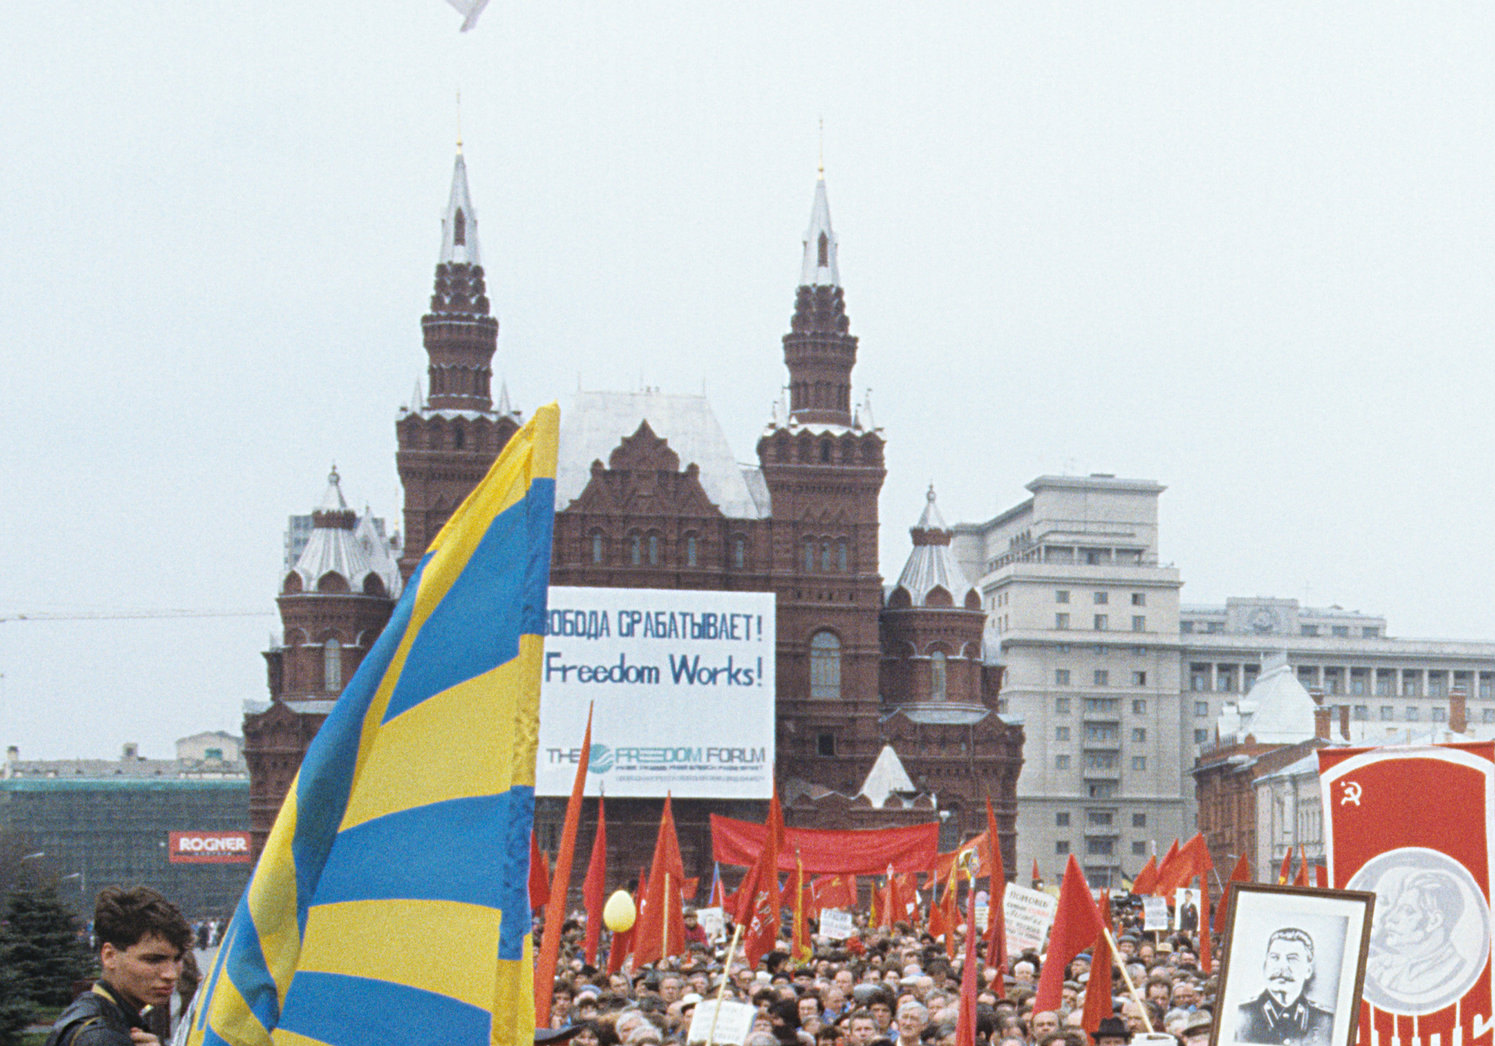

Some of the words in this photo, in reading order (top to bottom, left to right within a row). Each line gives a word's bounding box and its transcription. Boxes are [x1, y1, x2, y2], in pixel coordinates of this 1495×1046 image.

[618, 610, 763, 642] СРАБАТЫВАЕТ!
[546, 651, 660, 685] Freedom
[669, 653, 763, 687] Works!
[547, 747, 580, 764] THE
[616, 747, 702, 763] FREEDOM
[706, 747, 766, 763] FORUM
[179, 836, 248, 852] ROGNER
